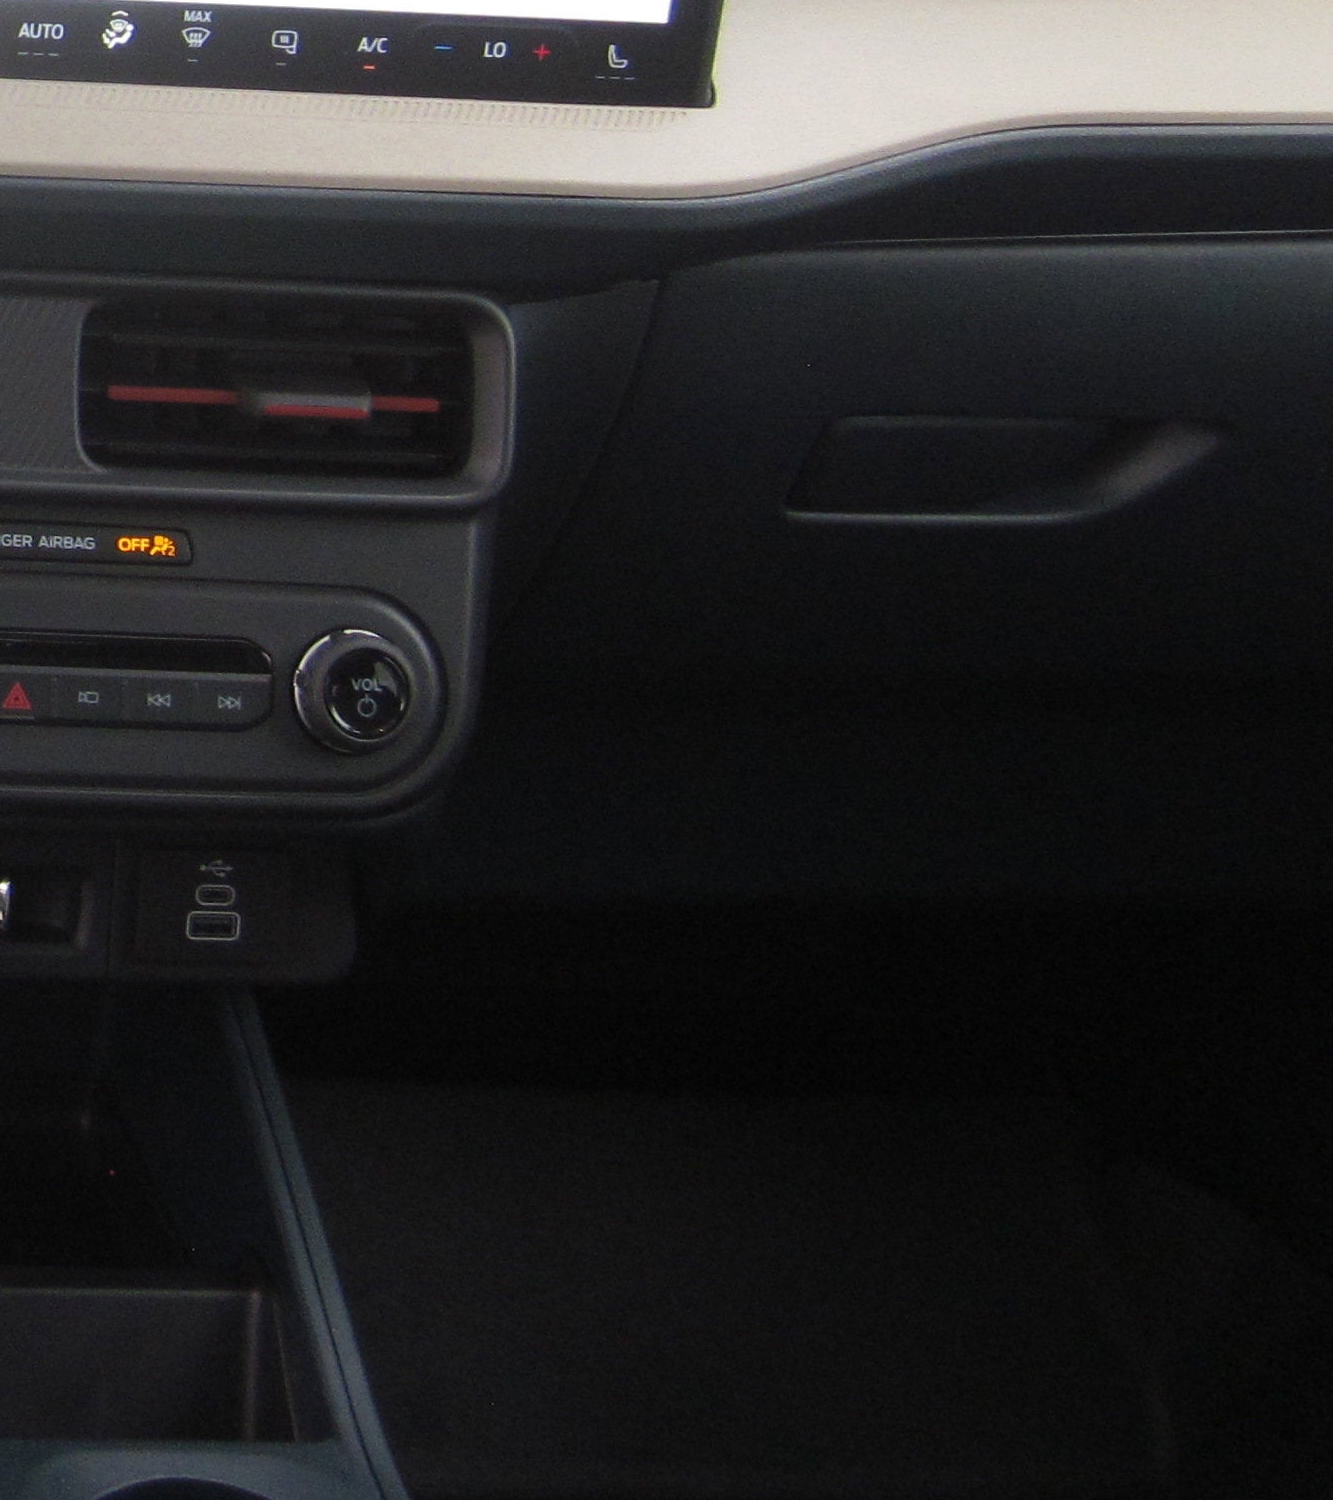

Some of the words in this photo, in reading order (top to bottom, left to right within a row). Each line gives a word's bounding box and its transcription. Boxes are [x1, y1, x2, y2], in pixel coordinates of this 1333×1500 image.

[184, 9, 213, 24] MAX
[18, 22, 64, 41] AUTO
[358, 36, 388, 56] A/C
[484, 41, 507, 59] LO
[38, 534, 96, 552] AIRBAG
[118, 536, 150, 552] OFF
[351, 679, 382, 692] VOL
